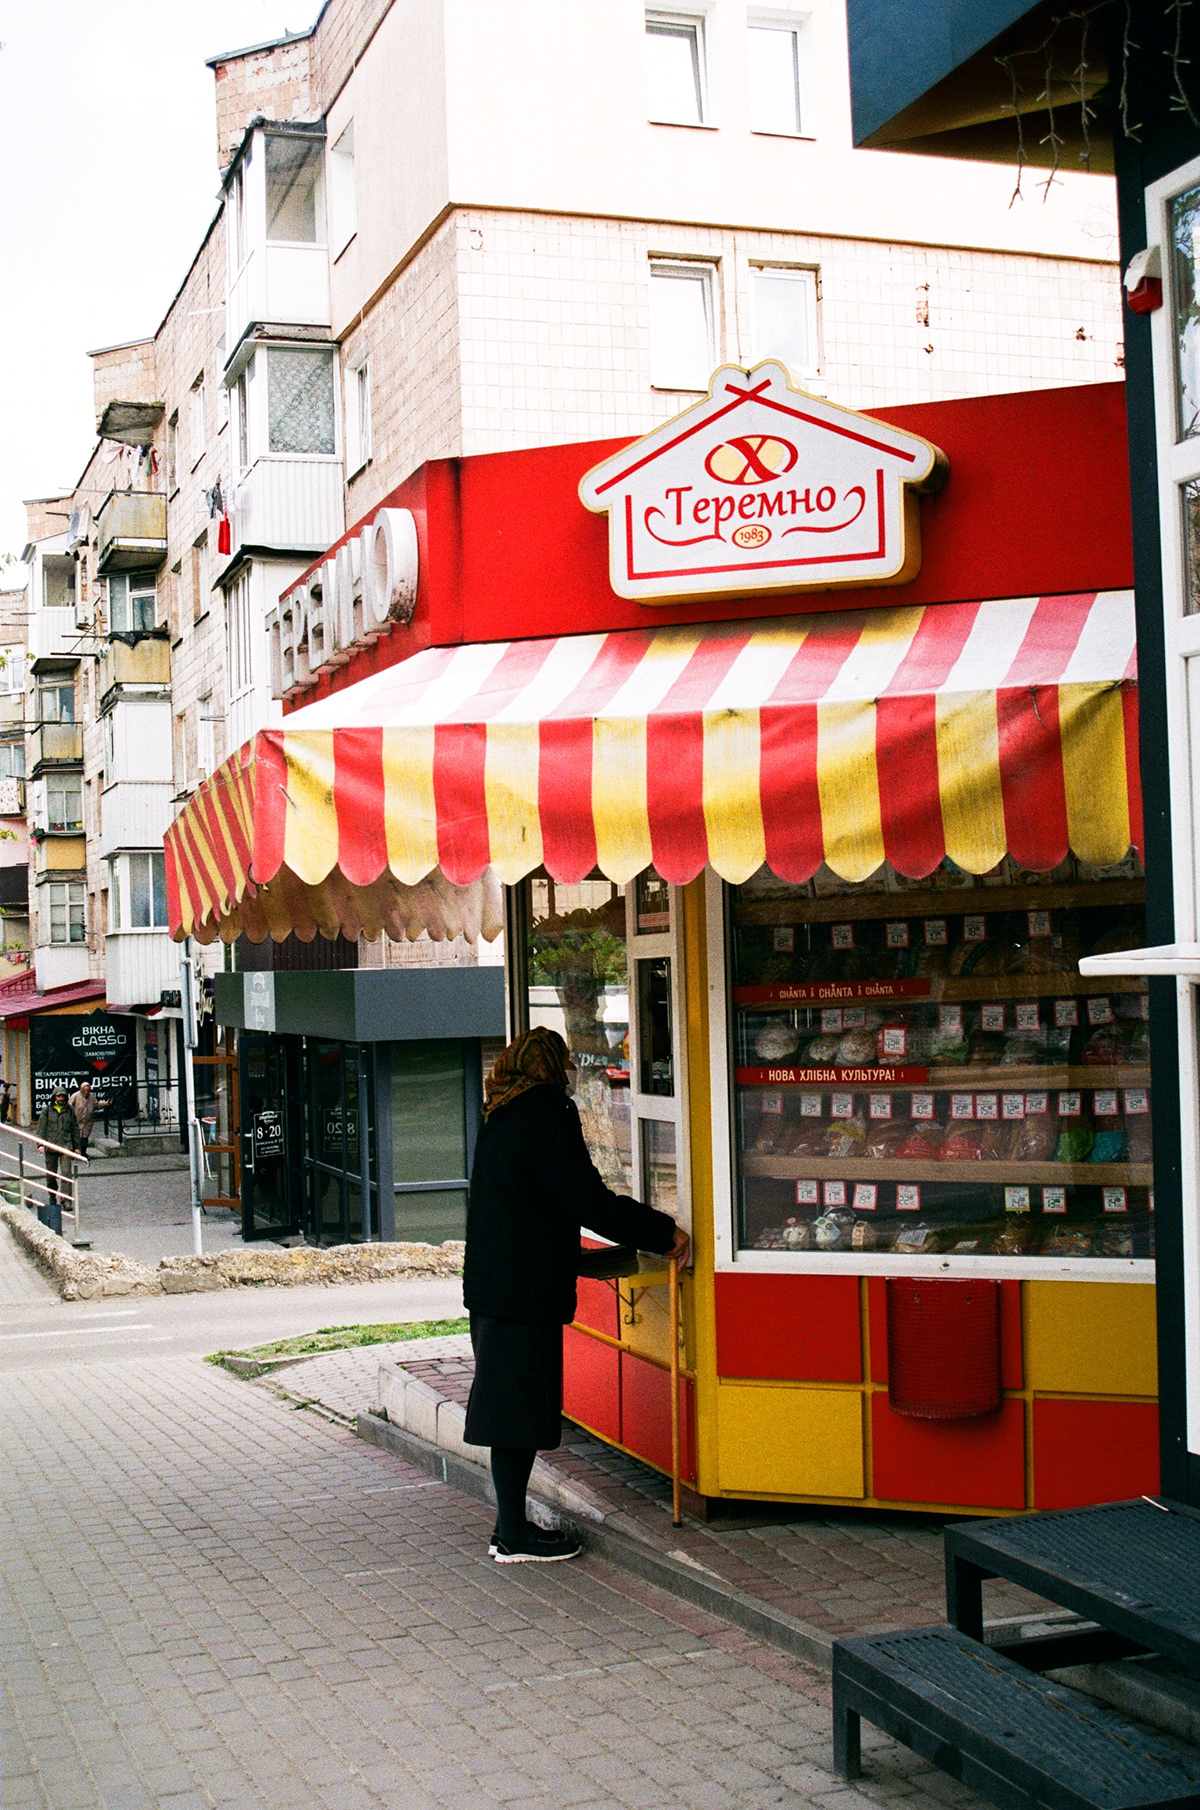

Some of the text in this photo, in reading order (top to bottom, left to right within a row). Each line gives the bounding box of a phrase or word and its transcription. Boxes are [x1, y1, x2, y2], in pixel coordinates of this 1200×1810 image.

[665, 485, 836, 539] Теремно
[739, 527, 764, 543] 1983
[82, 1025, 116, 1035] ВІКНА
[72, 1035, 127, 1047] GLASSO
[768, 1069, 895, 1081] НОВА ХЛІБНА КУЛЬТУРА!
[35, 1077, 79, 1090] ВІКНА
